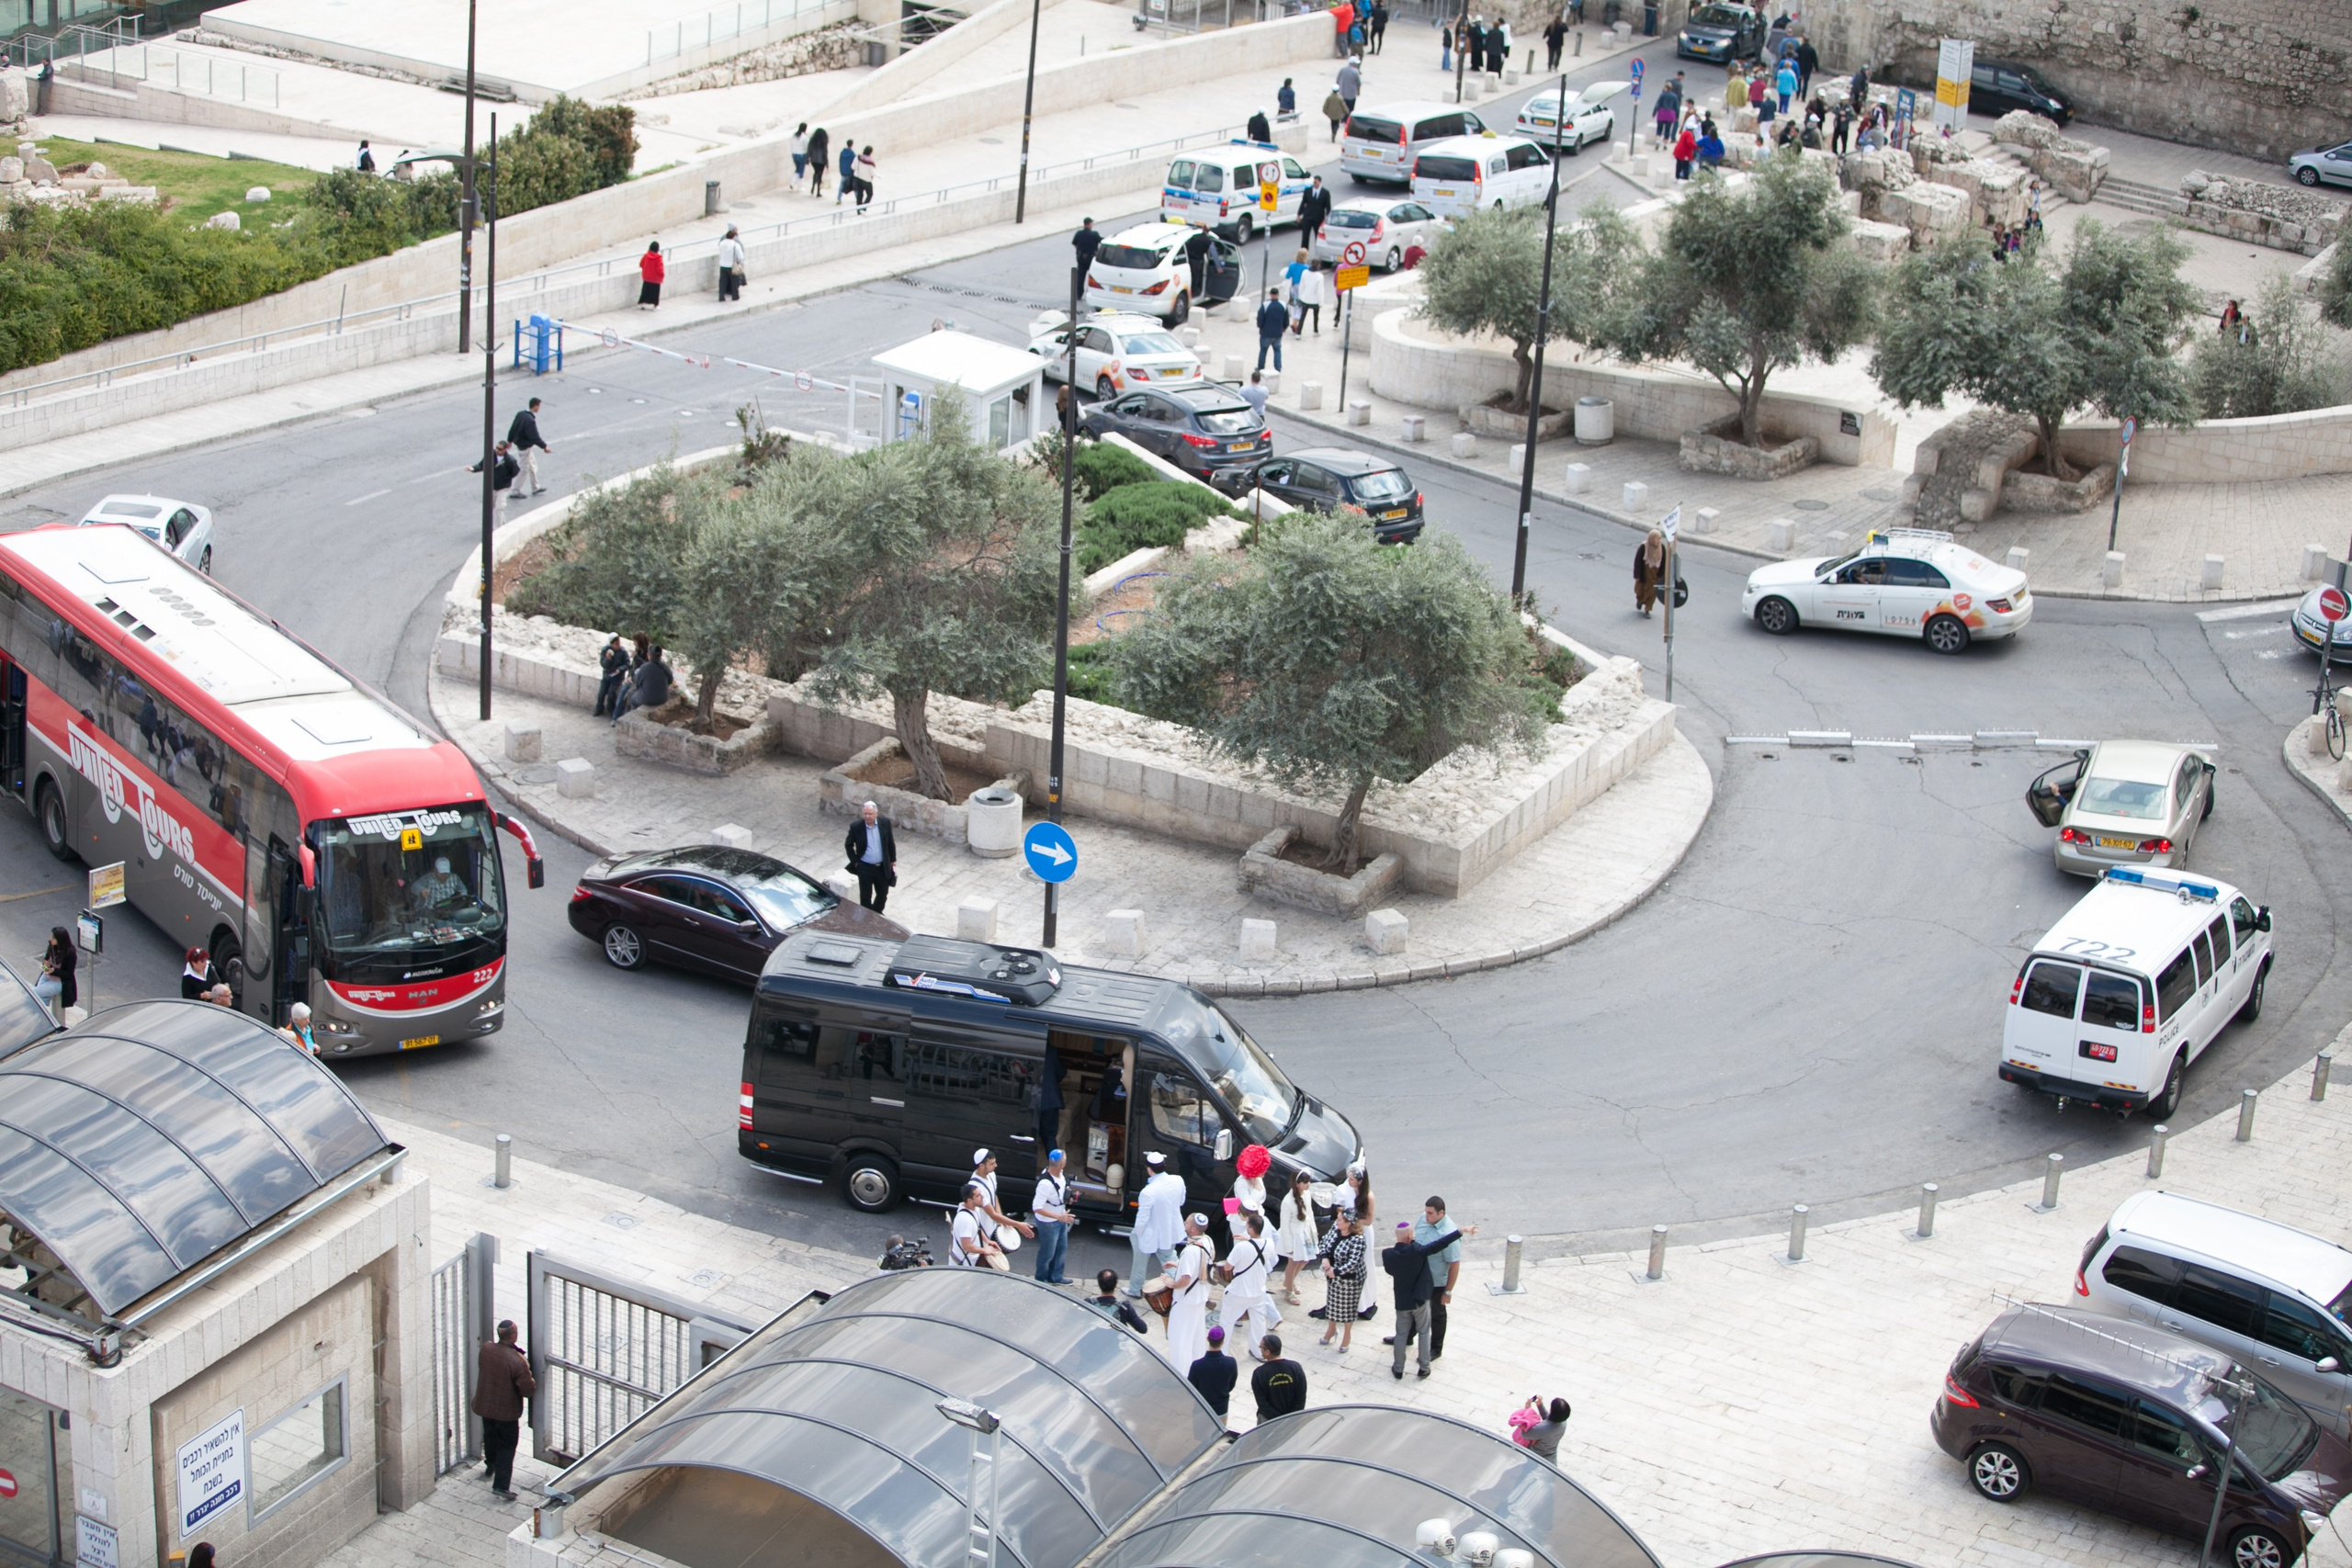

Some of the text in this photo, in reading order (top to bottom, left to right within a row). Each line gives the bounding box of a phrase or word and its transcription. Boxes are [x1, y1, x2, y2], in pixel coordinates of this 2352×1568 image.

[67, 719, 196, 864] UNITED TOURS
[346, 809, 462, 840] UNITED TOURS
[174, 863, 222, 911] יונייטד טורס
[2058, 937, 2136, 964] 722
[473, 968, 493, 983] 222
[408, 988, 438, 998] MAN
[2158, 1023, 2180, 1049] POLICE
[183, 1422, 240, 1469] אין להשאיר רכבים
[190, 1446, 233, 1483] בחניית הכותל
[203, 1473, 223, 1495] בשבת
[225, 1483, 238, 1498] רכב
[210, 1493, 224, 1506] חונה
[80, 1517, 116, 1539] אין מעבר
[85, 1532, 110, 1548] להולכי
[91, 1544, 106, 1557] רגל
